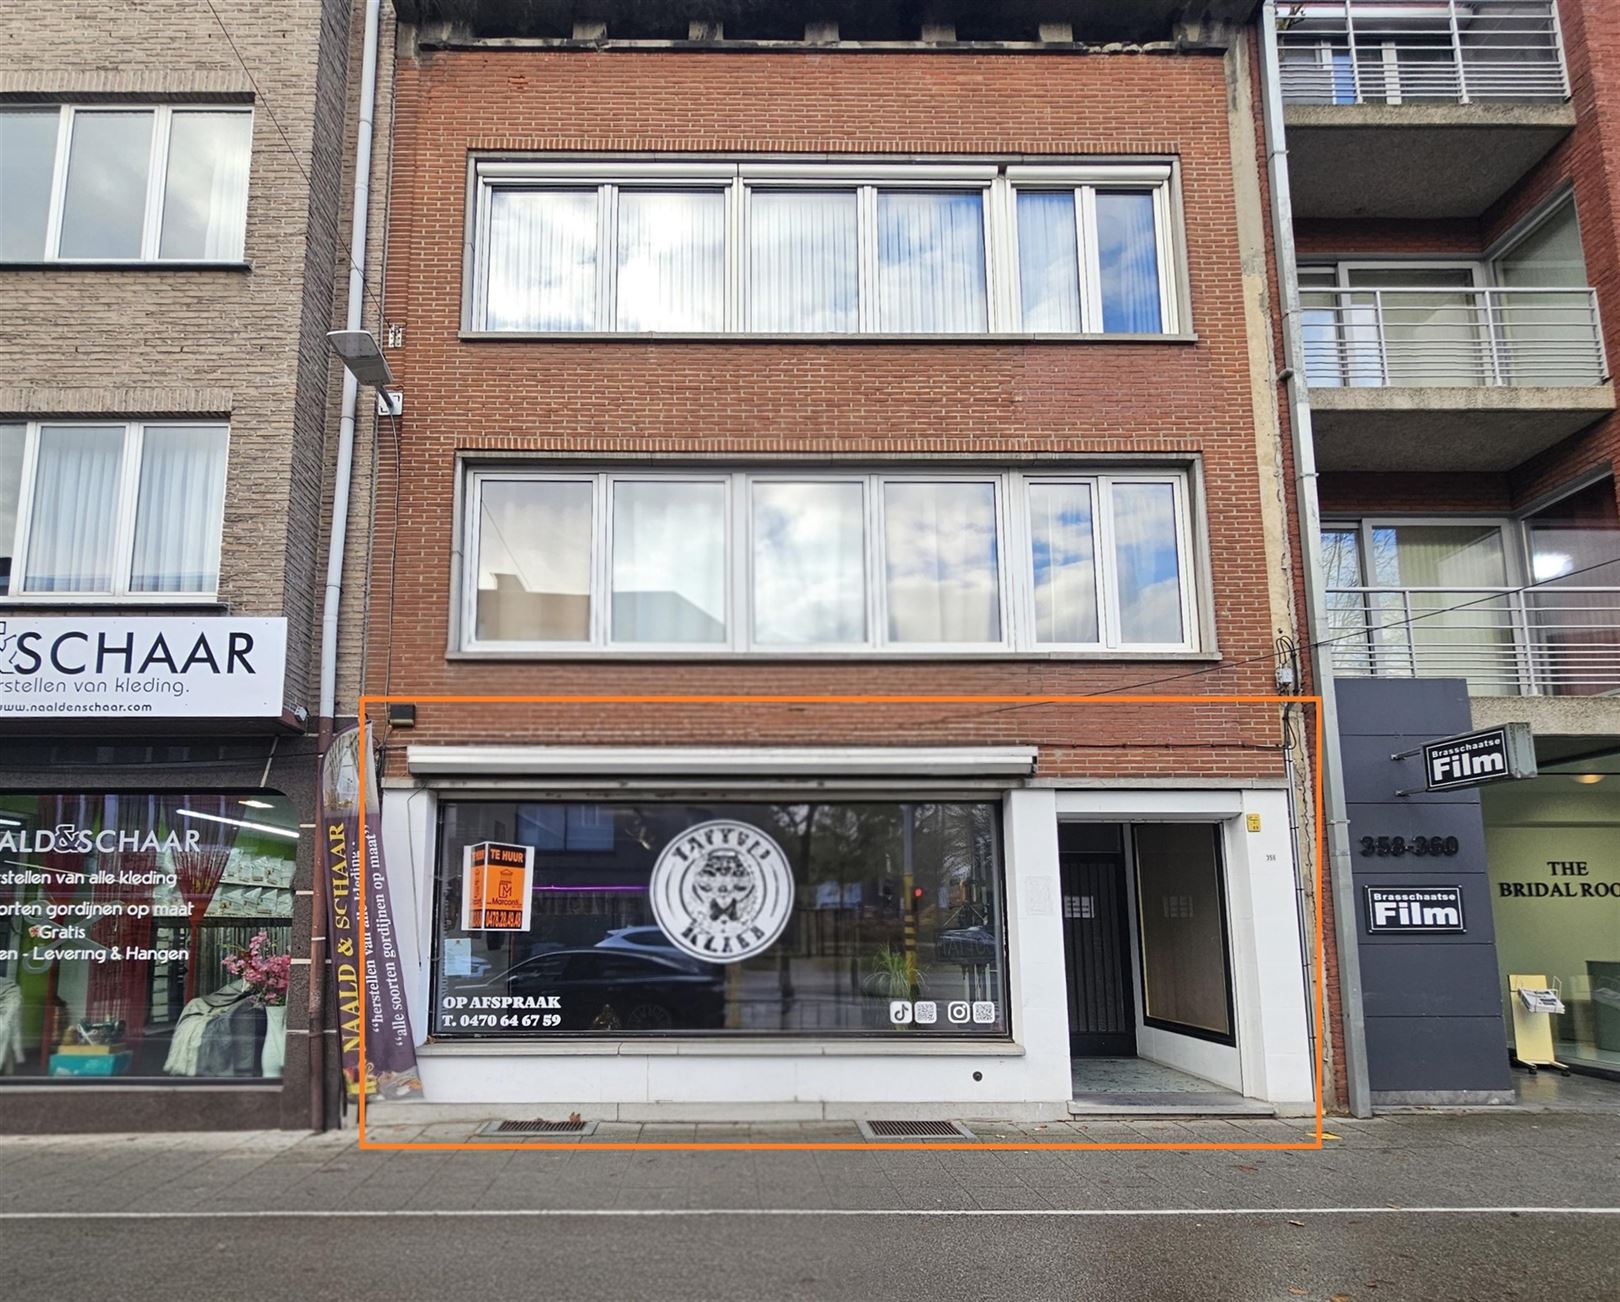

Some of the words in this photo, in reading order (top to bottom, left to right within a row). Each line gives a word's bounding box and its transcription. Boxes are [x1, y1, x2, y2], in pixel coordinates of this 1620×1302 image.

[75, 680, 108, 693] van
[115, 677, 190, 696] kleding.
[1432, 738, 1500, 758] Brasschaatse
[1433, 751, 1504, 781] Film
[1360, 836, 1459, 857] 358-360
[490, 849, 501, 860] TE
[502, 851, 524, 863] HUUR
[329, 823, 350, 929] SCHAAR
[1547, 861, 1589, 876] THE
[0, 870, 51, 884] stellen
[56, 872, 85, 884] van
[89, 870, 115, 885] alle
[119, 870, 178, 887] kleding
[372, 873, 384, 890] op
[1374, 893, 1456, 901] Brasschaatse
[1499, 882, 1577, 897] BRIDAL
[46, 901, 123, 919] gordijnen
[127, 904, 150, 919] op
[153, 901, 195, 916] maat
[1375, 902, 1459, 925] Film
[39, 925, 86, 939] Gratis
[376, 894, 397, 958] gordijnen
[33, 946, 106, 963] Levering
[110, 946, 123, 960] &
[126, 946, 189, 963] Hangen
[337, 937, 354, 957] &
[385, 962, 403, 1009] soorten
[442, 996, 468, 1009] OP
[469, 996, 561, 1009] AFSPRAAK
[442, 1014, 457, 1026] T.
[460, 1014, 497, 1027] 0470
[500, 1014, 518, 1027] 64
[522, 1014, 540, 1027] 67
[542, 1014, 561, 1027] 59
